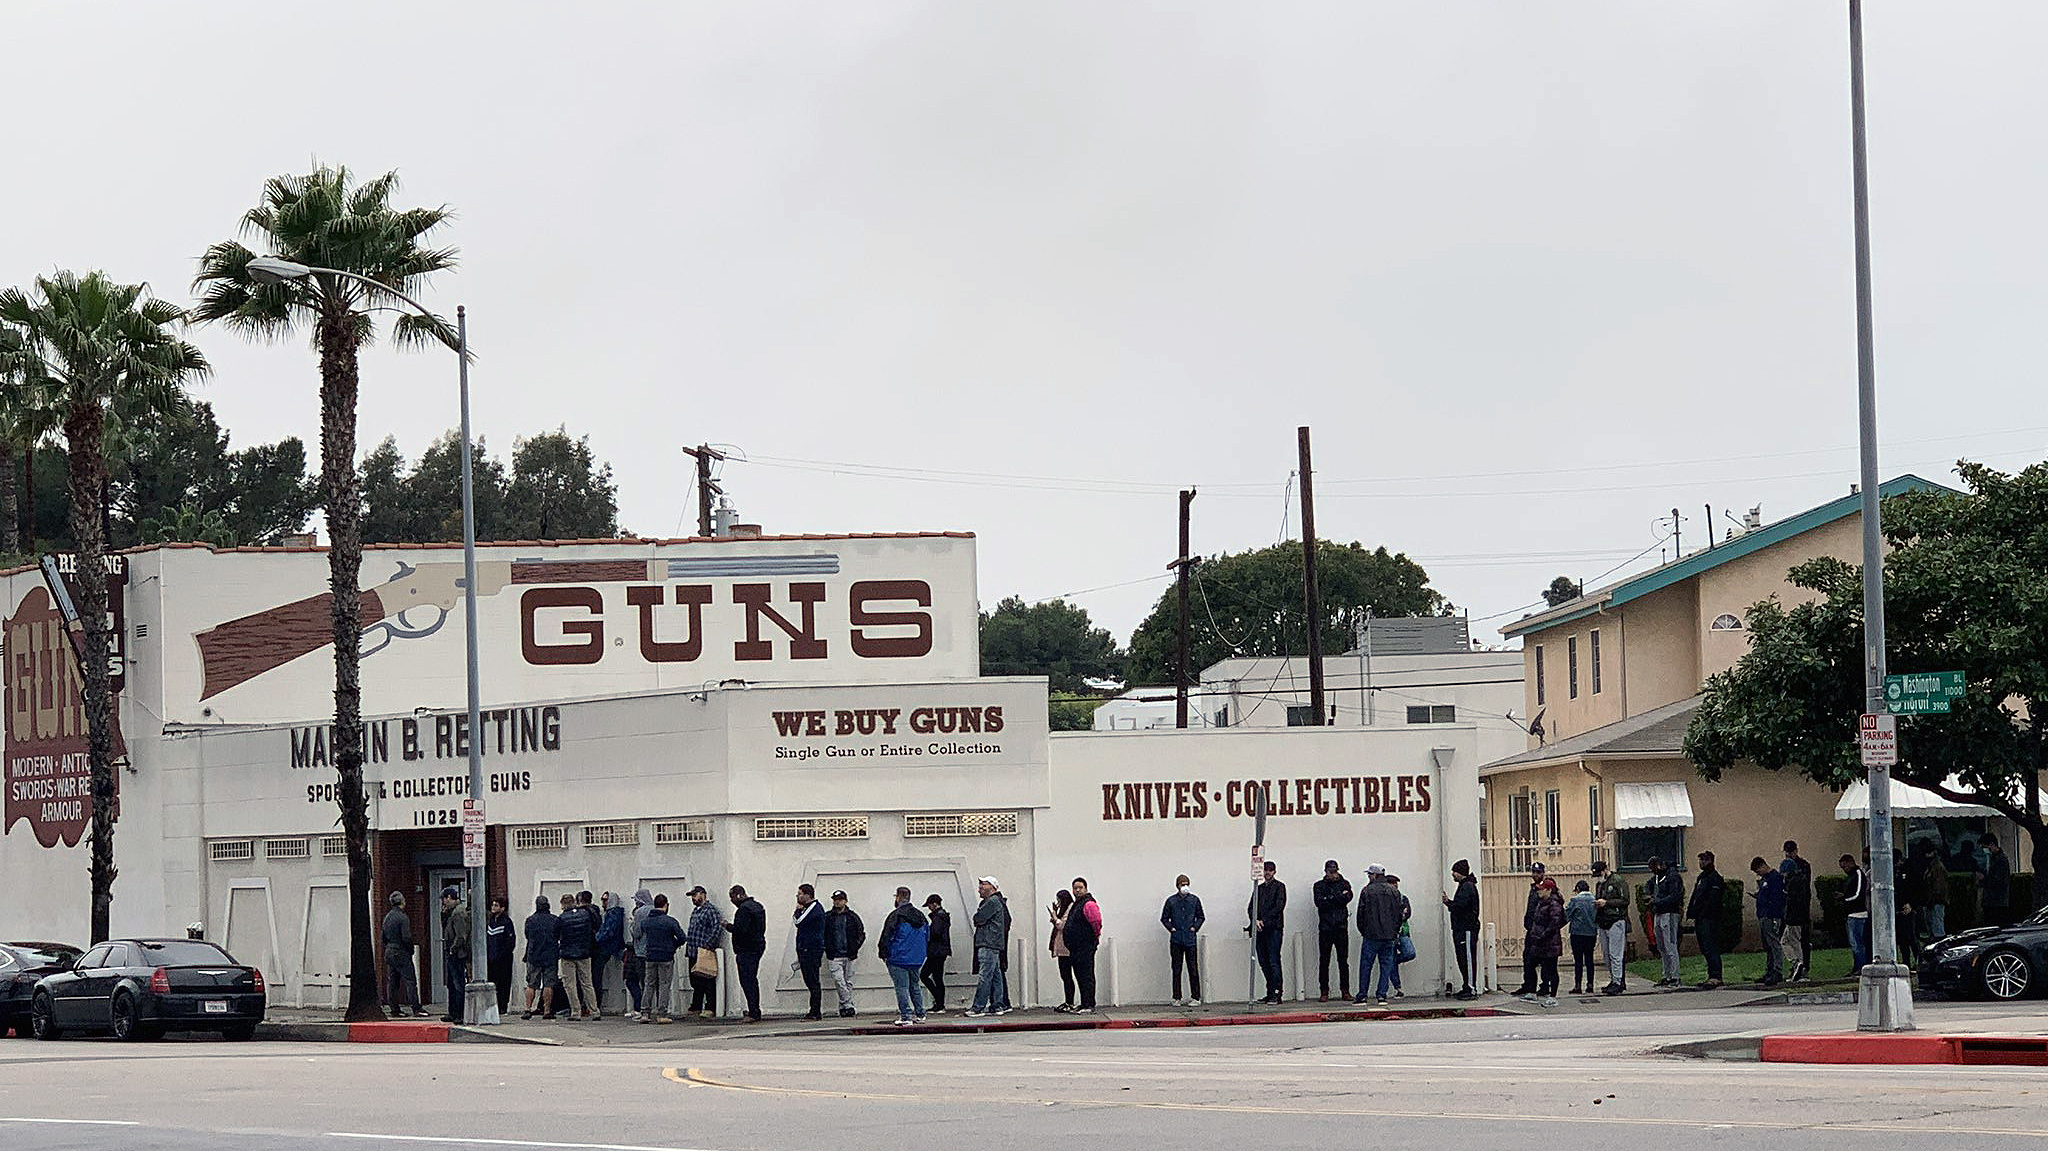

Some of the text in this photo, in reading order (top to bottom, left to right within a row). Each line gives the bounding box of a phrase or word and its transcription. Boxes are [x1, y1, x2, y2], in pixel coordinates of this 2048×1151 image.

[58, 553, 123, 575] RENG
[520, 579, 933, 666] GUNS
[11, 617, 91, 742] GUN
[1903, 674, 1963, 698] Washington BL
[1944, 685, 1963, 696] 11000
[1932, 701, 1949, 711] 3900
[771, 705, 1005, 737] WE BUY GUNS
[1862, 716, 1875, 729] NO
[402, 717, 425, 762] B.
[1863, 730, 1894, 741] PARKING
[775, 742, 1002, 761] Single Gun or Entire Collection
[12, 755, 54, 778] MODERN
[12, 779, 54, 802] SWORDS
[57, 777, 76, 798] WAR
[490, 770, 532, 793] GUNS
[1101, 774, 1432, 821] KNIVES COLLECTIBLES
[40, 801, 83, 823] ARMOUR
[413, 809, 458, 827] 11029
